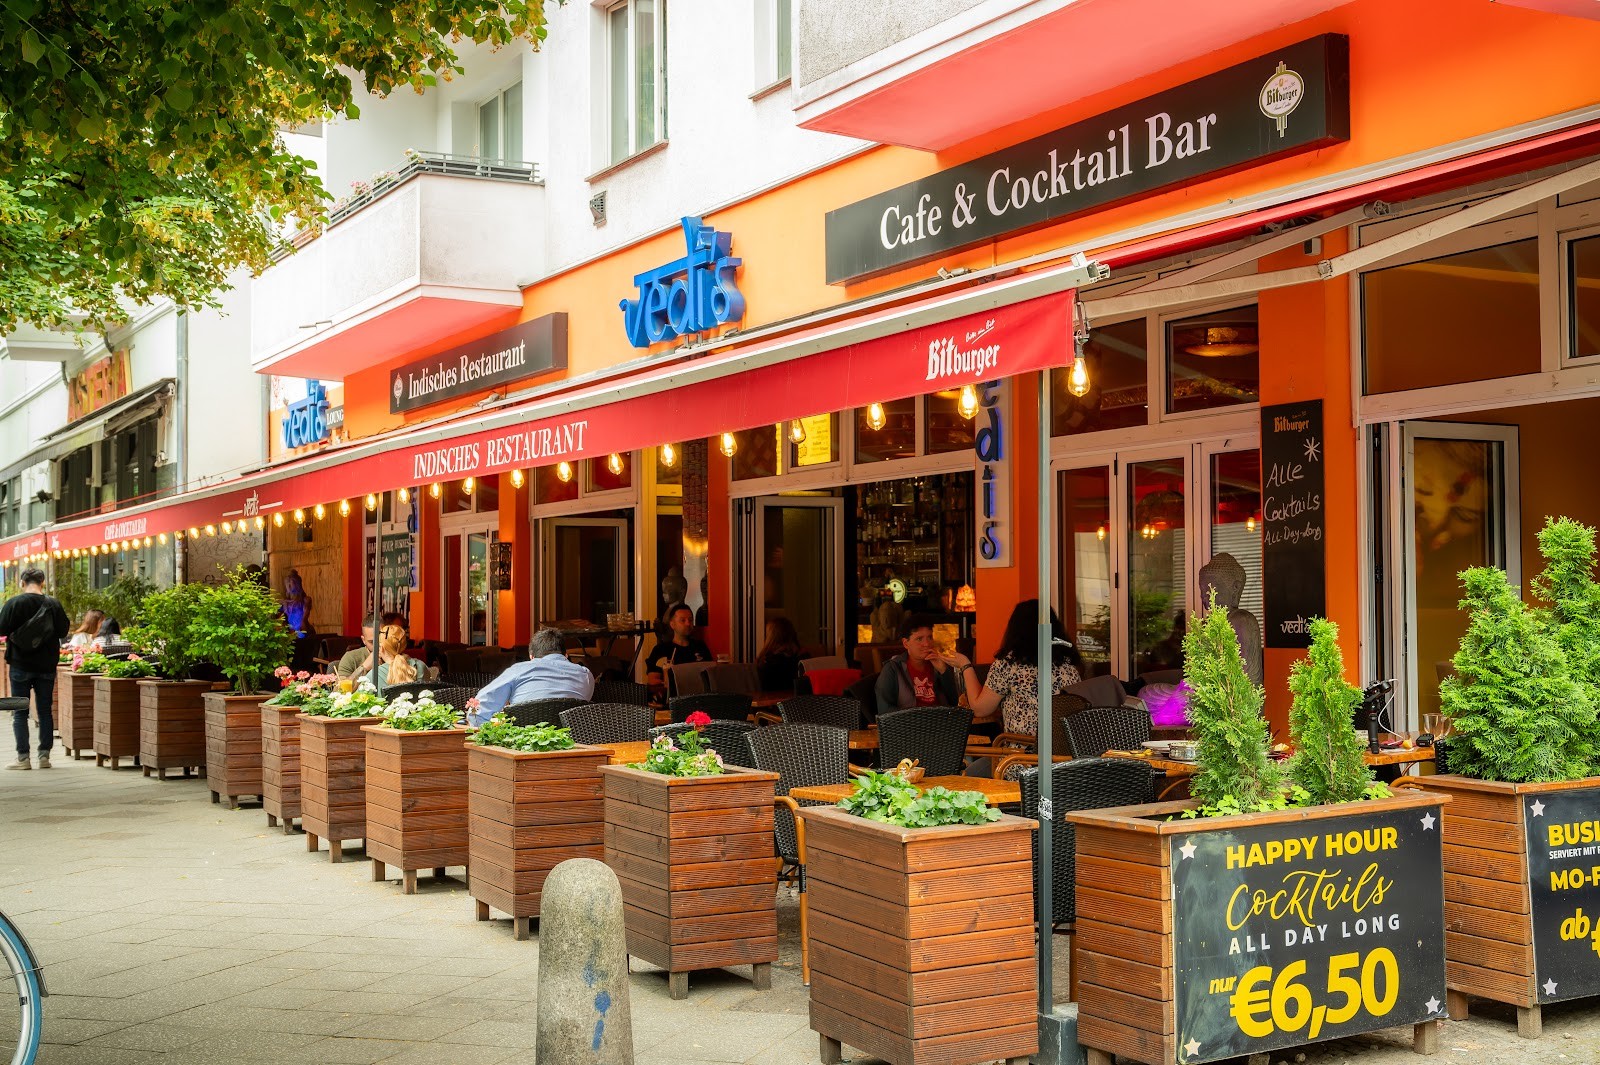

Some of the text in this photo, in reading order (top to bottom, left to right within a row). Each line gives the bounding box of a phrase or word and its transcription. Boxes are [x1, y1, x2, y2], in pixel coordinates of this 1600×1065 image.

[1267, 88, 1298, 106] Bitburger
[880, 111, 1218, 250] Cafe & Cocktail Bar
[408, 339, 526, 399] Indisches Restaurant
[926, 336, 1001, 380] Bitburger
[1273, 415, 1309, 433] Bitburger
[413, 421, 588, 480] INDISCHES RESTAURANT
[1226, 827, 1398, 870] HAPPY HOUR
[1549, 847, 1582, 860] SERVIERT
[1583, 846, 1596, 856] MIT
[1228, 913, 1400, 955] ALL DAY LONG
[1560, 908, 1590, 941] ab
[1209, 947, 1400, 1039] nur €6,50
